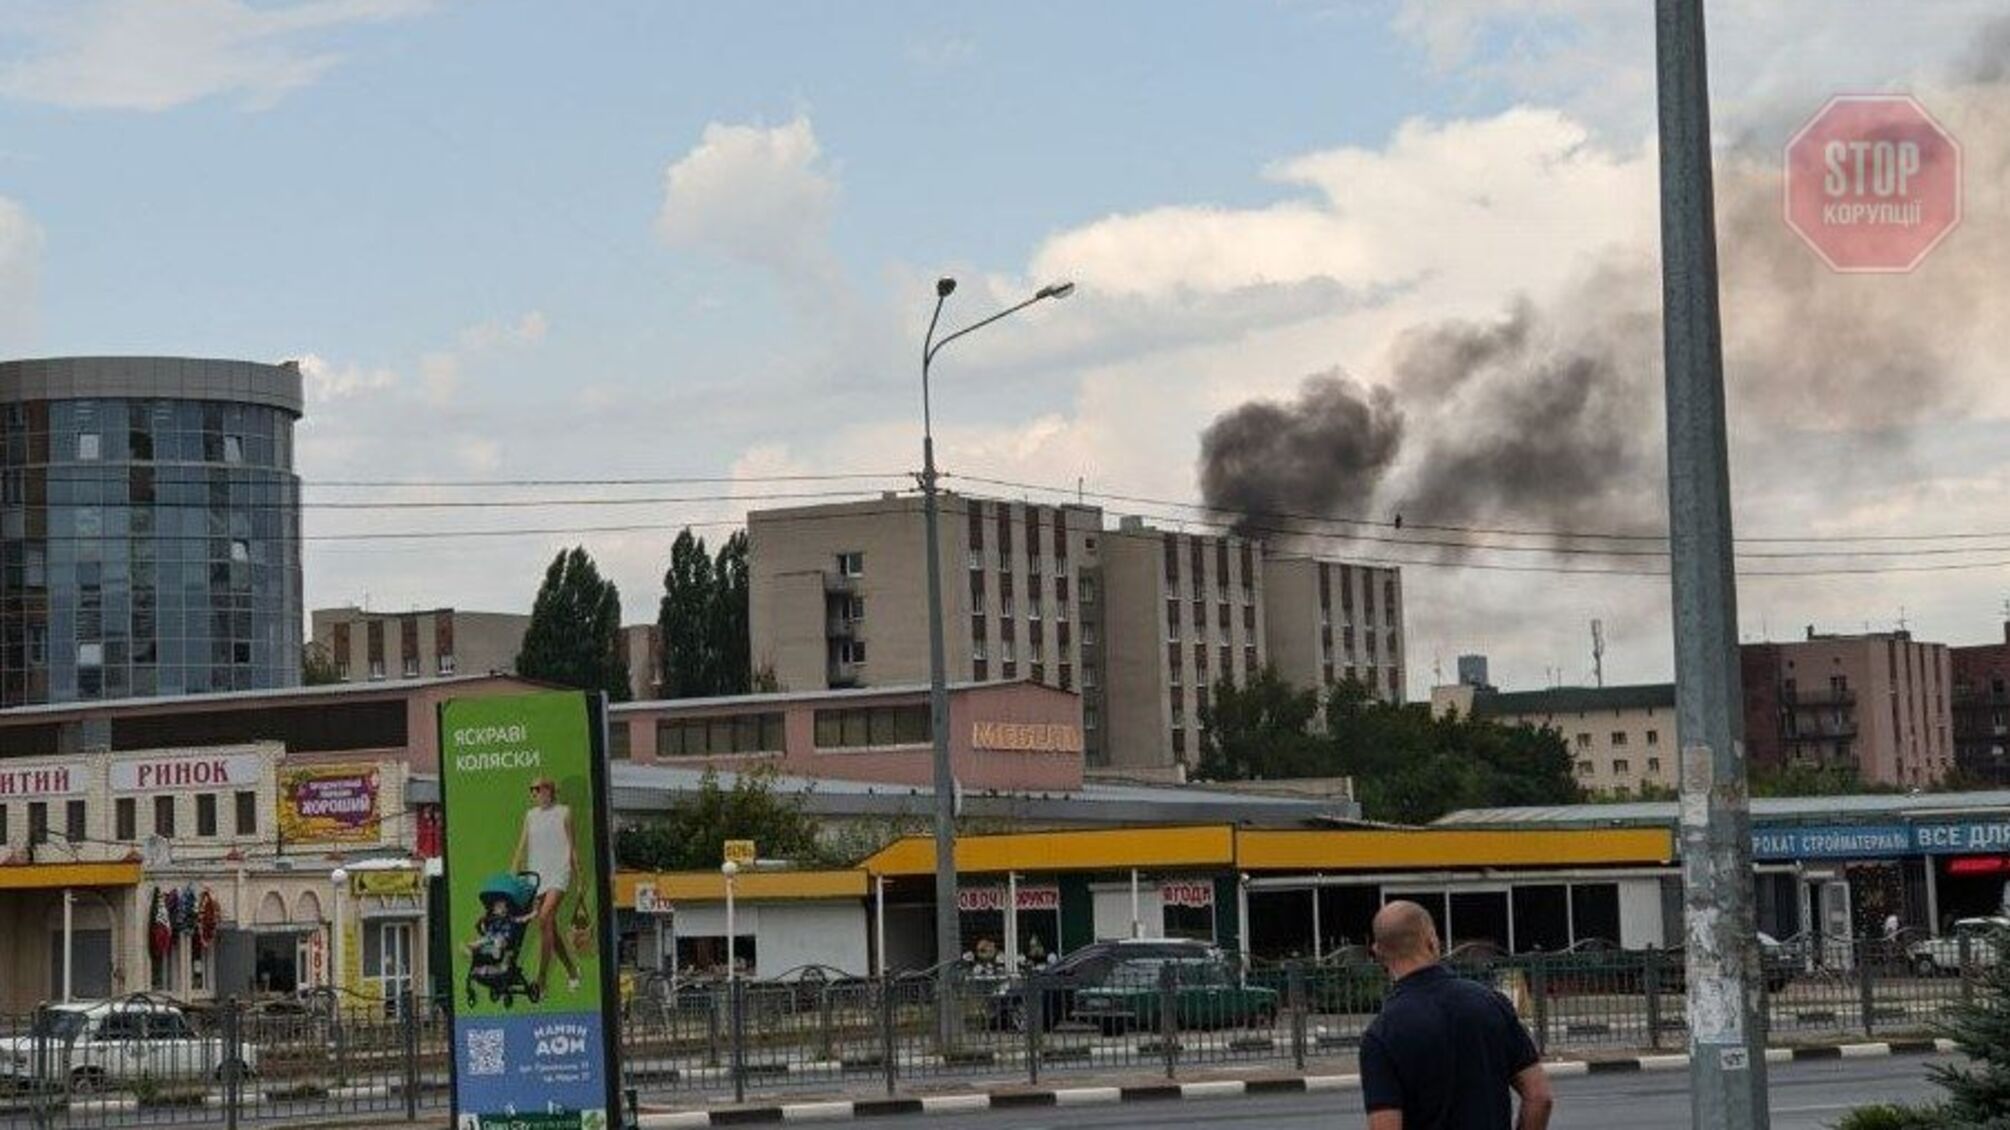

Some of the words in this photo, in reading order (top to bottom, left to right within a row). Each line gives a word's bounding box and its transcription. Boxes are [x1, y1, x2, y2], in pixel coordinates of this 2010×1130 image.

[454, 725, 526, 746] ЯСКРАВІ
[456, 749, 540, 771] КОЛЯСКИ
[137, 759, 229, 787] РИНОК
[1918, 827, 1962, 846] ВСЕ
